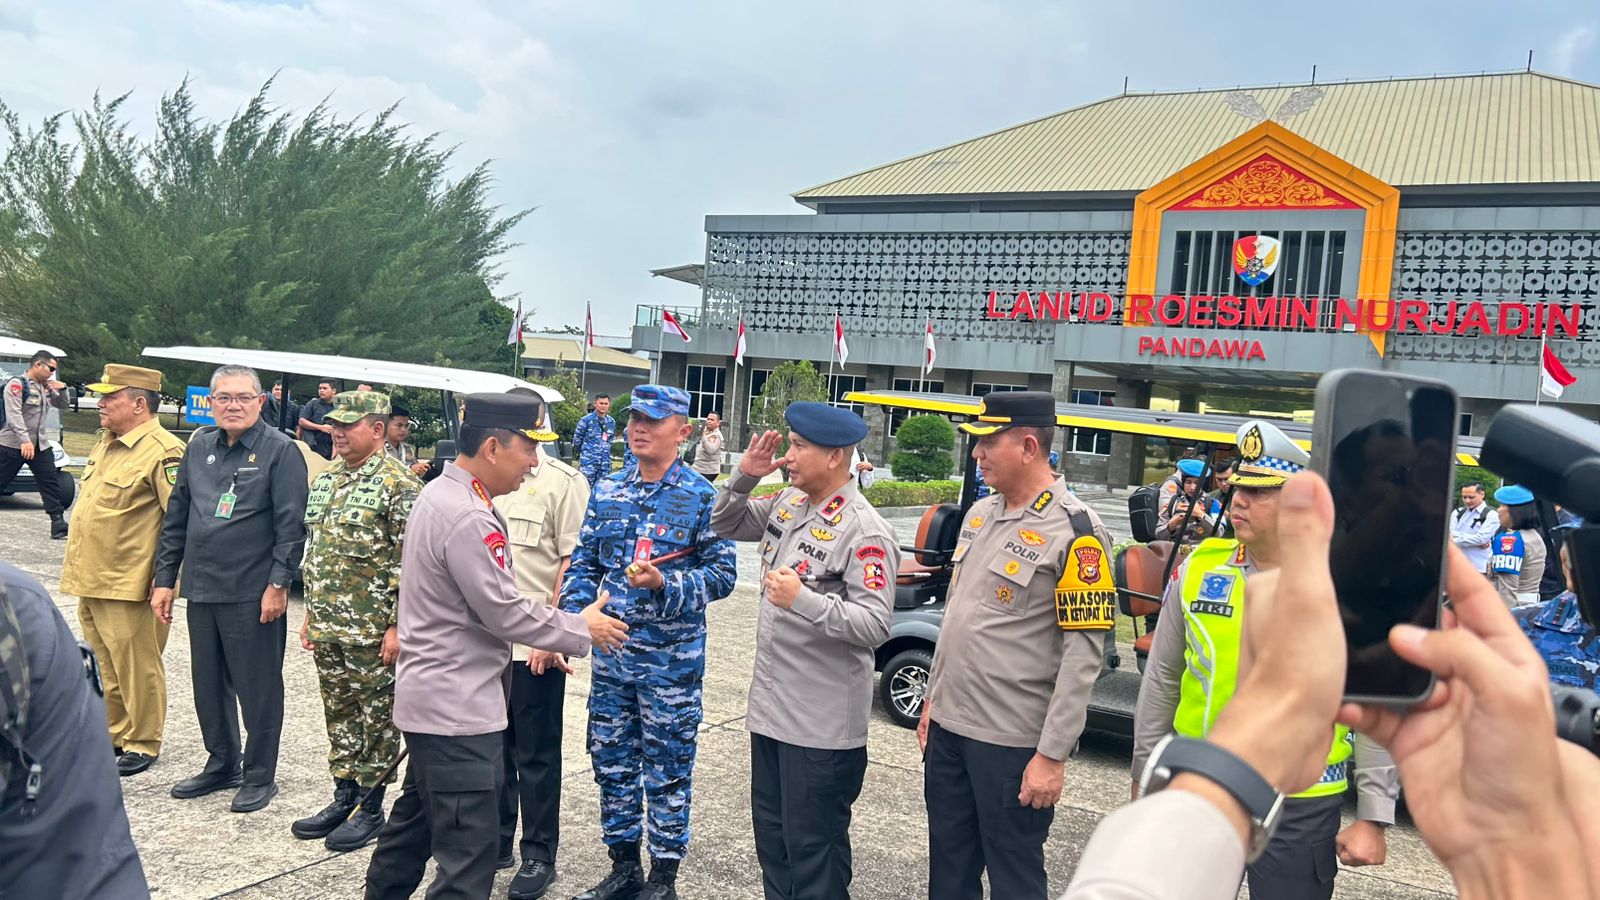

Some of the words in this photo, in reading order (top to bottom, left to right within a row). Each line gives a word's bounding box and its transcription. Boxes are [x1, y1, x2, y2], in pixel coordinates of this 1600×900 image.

[986, 290, 1114, 322] LANUD
[1128, 294, 1318, 329] ROESMIN
[1334, 297, 1581, 337] NURJADIN
[1138, 335, 1266, 360] PANDAWA
[363, 498, 376, 506] AD
[797, 541, 827, 562] POLRI
[1004, 541, 1039, 562] POLRI
[1070, 606, 1100, 622] KETUPAT
